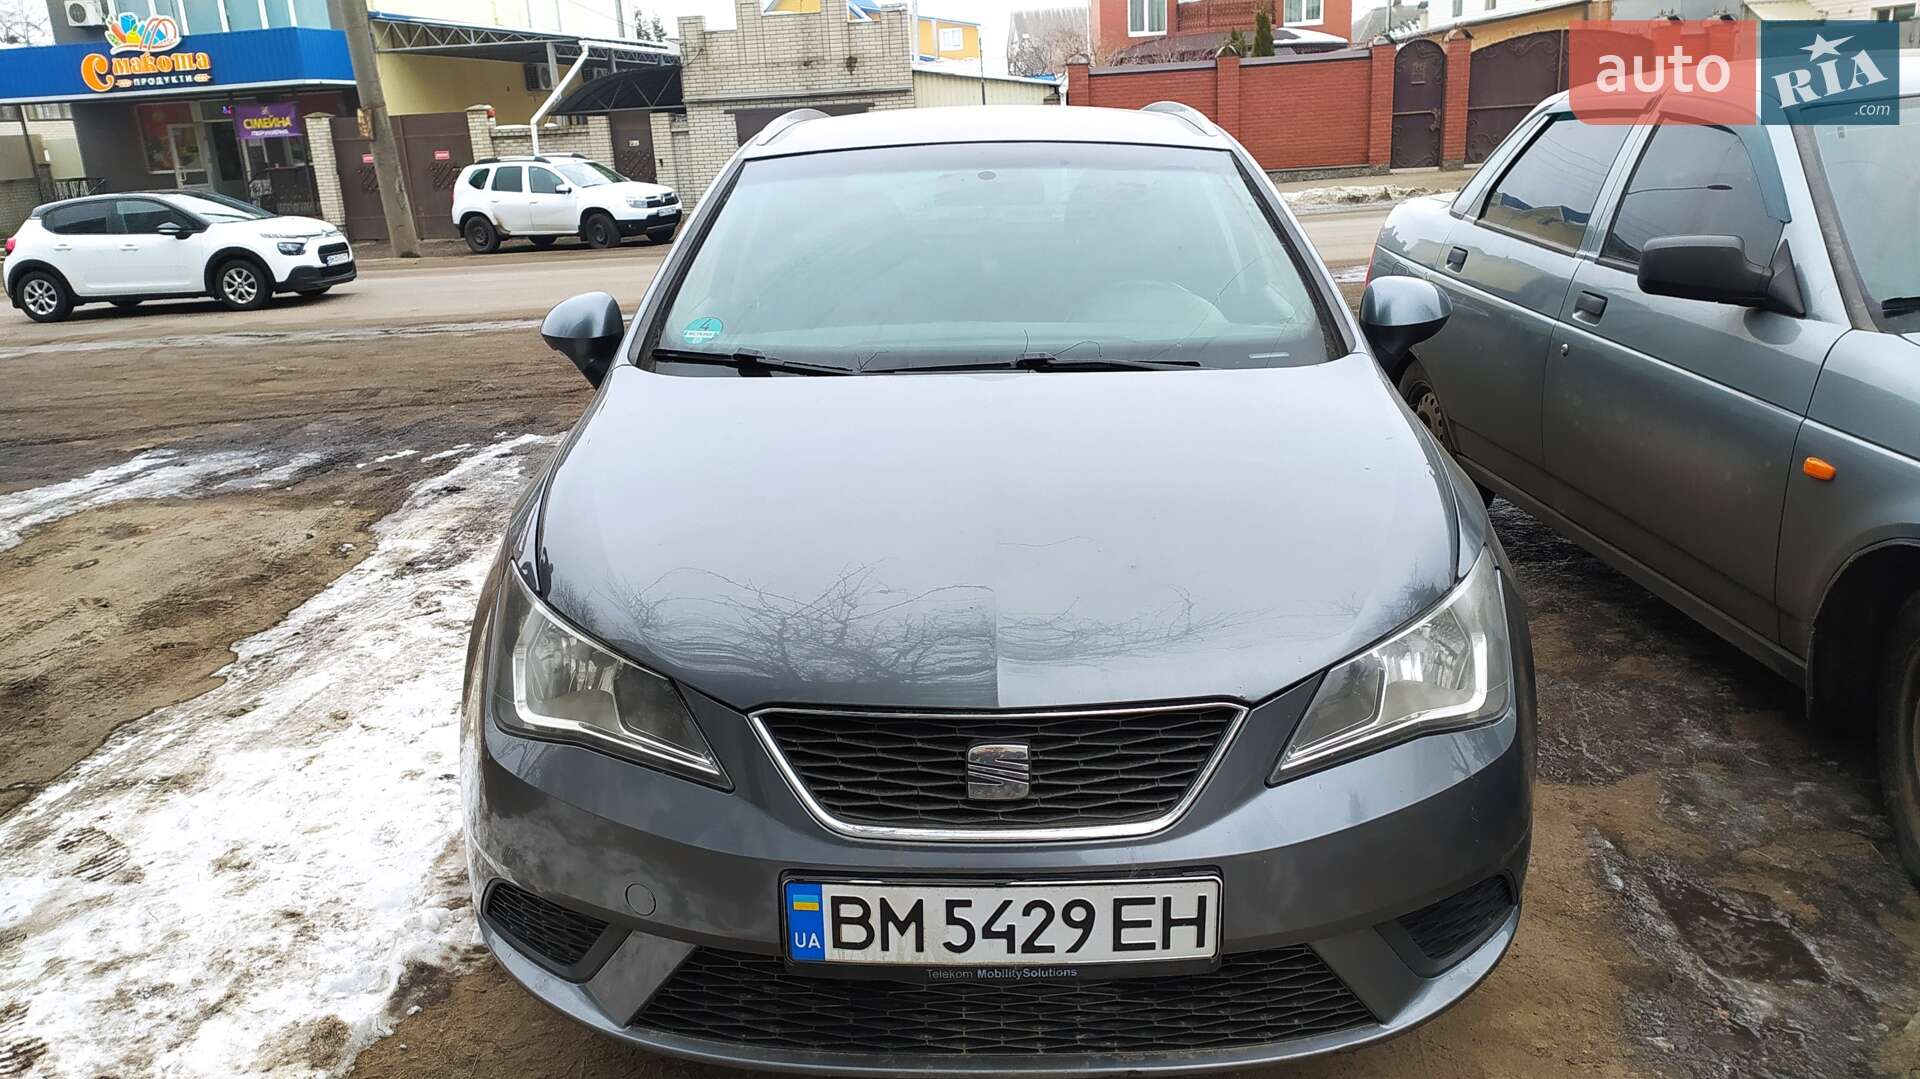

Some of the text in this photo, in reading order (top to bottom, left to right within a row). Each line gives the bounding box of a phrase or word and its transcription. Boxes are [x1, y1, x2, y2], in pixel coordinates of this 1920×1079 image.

[81, 52, 211, 93] Смакота
[133, 74, 193, 86] ПРОДУКТИ
[830, 895, 1207, 954] BM 5429 EH
[795, 932, 821, 949] UA
[927, 968, 1078, 980] Telekom MobilitySolutions
